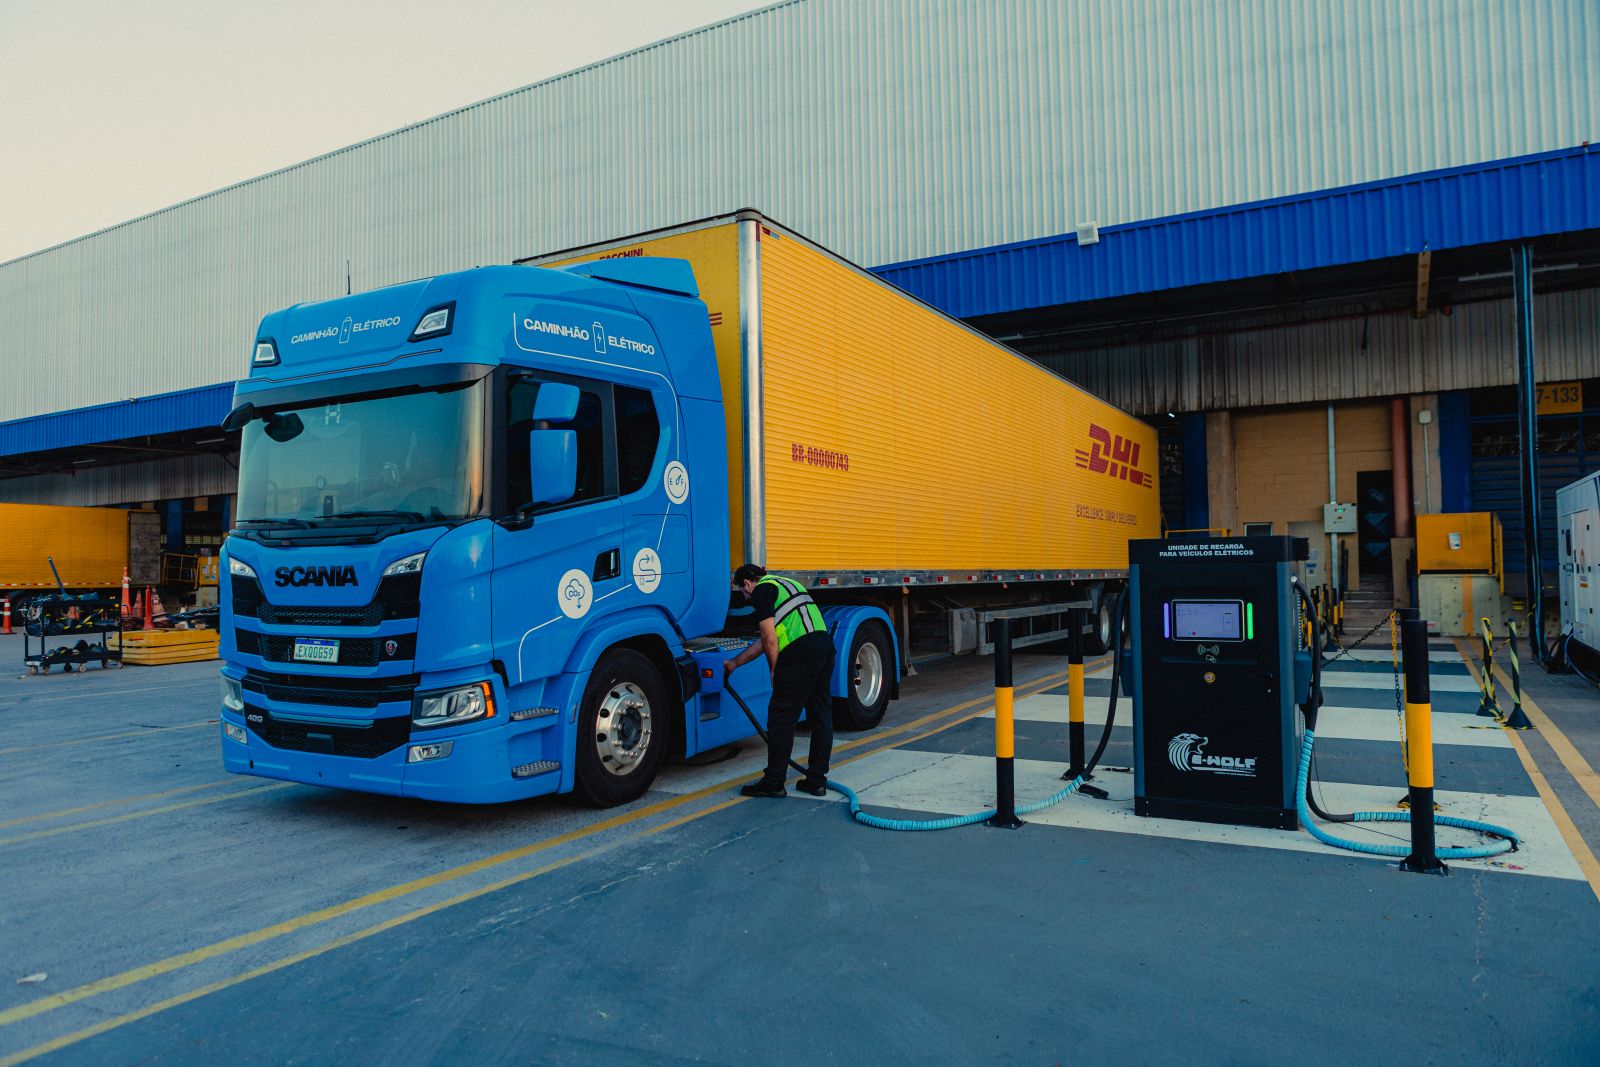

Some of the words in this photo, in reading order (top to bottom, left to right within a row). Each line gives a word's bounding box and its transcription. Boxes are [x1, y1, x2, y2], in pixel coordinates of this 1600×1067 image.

[290, 327, 339, 344] CAMINHÃO
[352, 316, 401, 332] ELÉTRICO
[523, 318, 590, 341] CAMINHÃO
[608, 335, 655, 356] ELÉTRICO
[1088, 422, 1144, 487] DHL
[1214, 549, 1254, 557] ELÉTRICOS
[274, 565, 359, 588] SCANIA
[1191, 755, 1255, 769] E-WOLF
